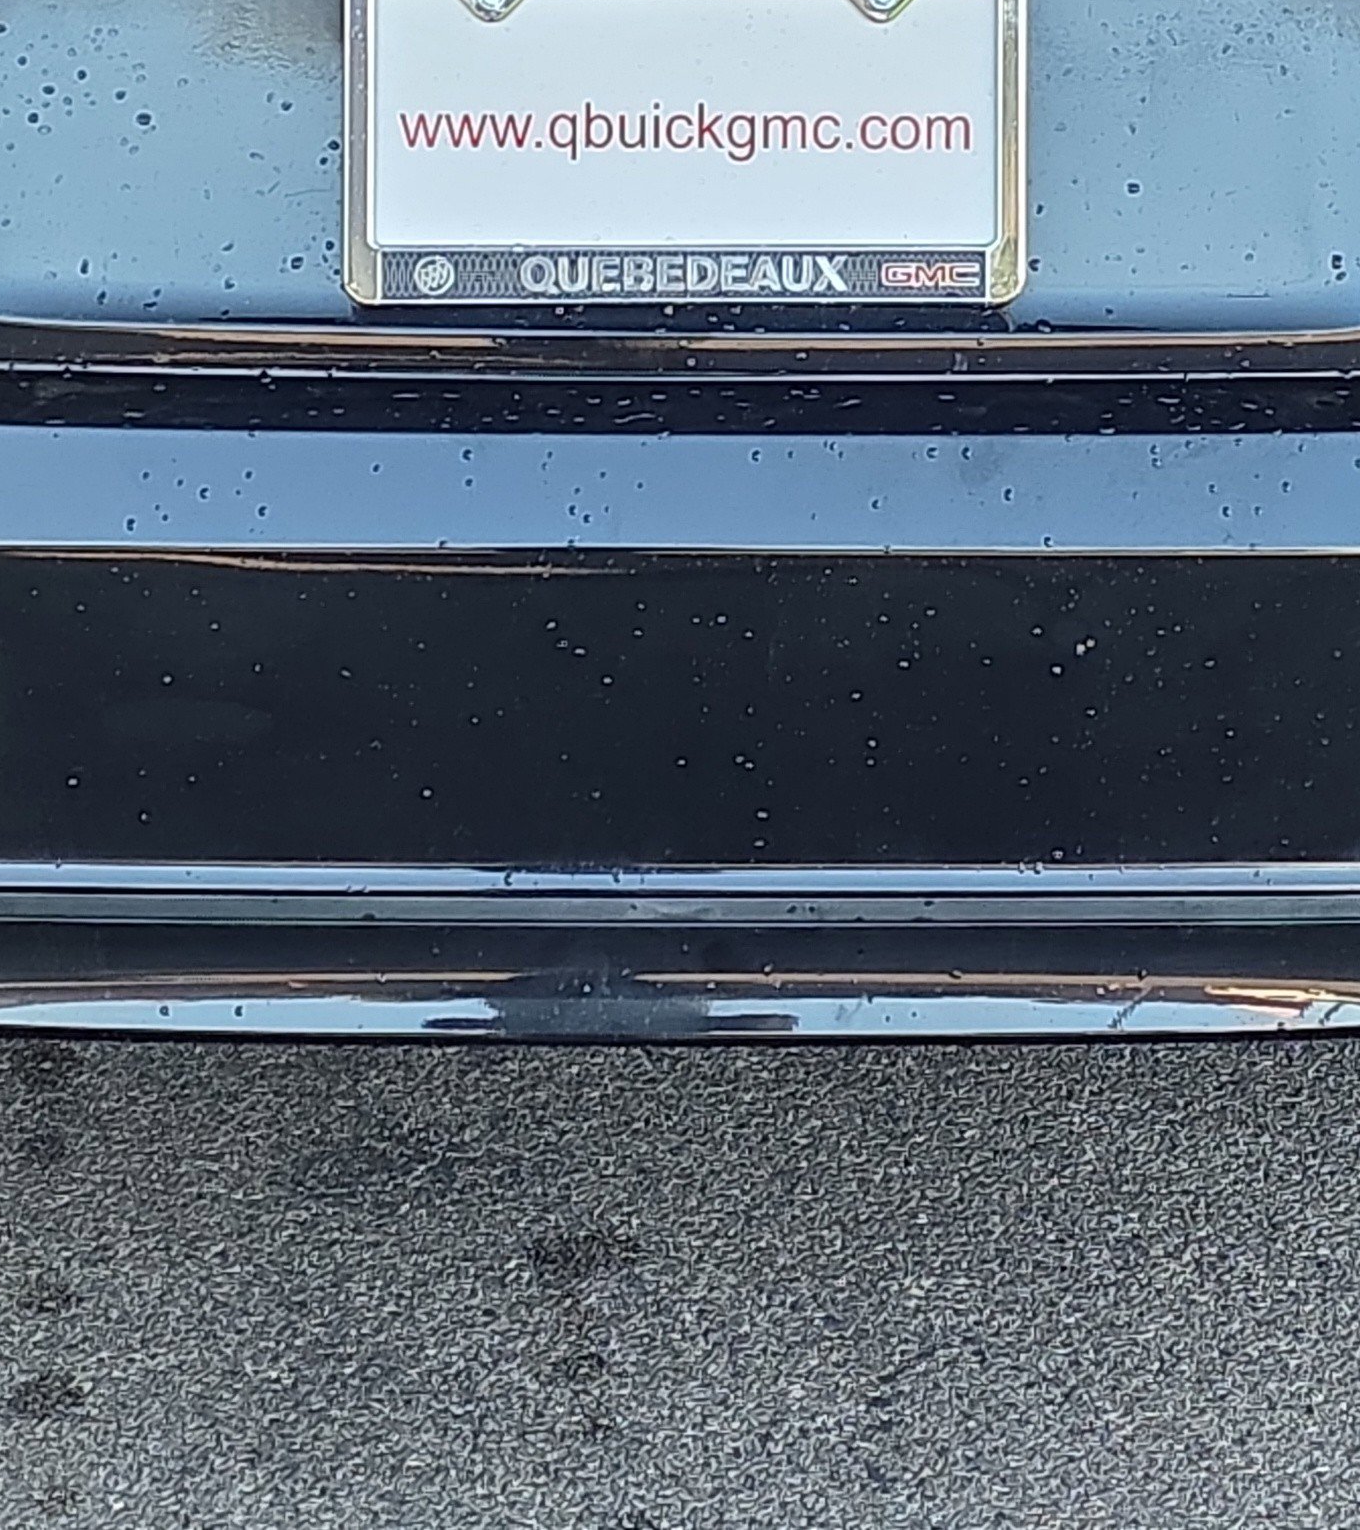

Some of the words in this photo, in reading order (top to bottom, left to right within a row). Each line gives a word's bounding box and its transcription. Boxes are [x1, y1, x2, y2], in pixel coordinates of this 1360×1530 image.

[399, 102, 972, 162] www.qbuickgmc.com
[519, 255, 849, 295] QUEBEDEAUX
[880, 262, 982, 287] GMC
